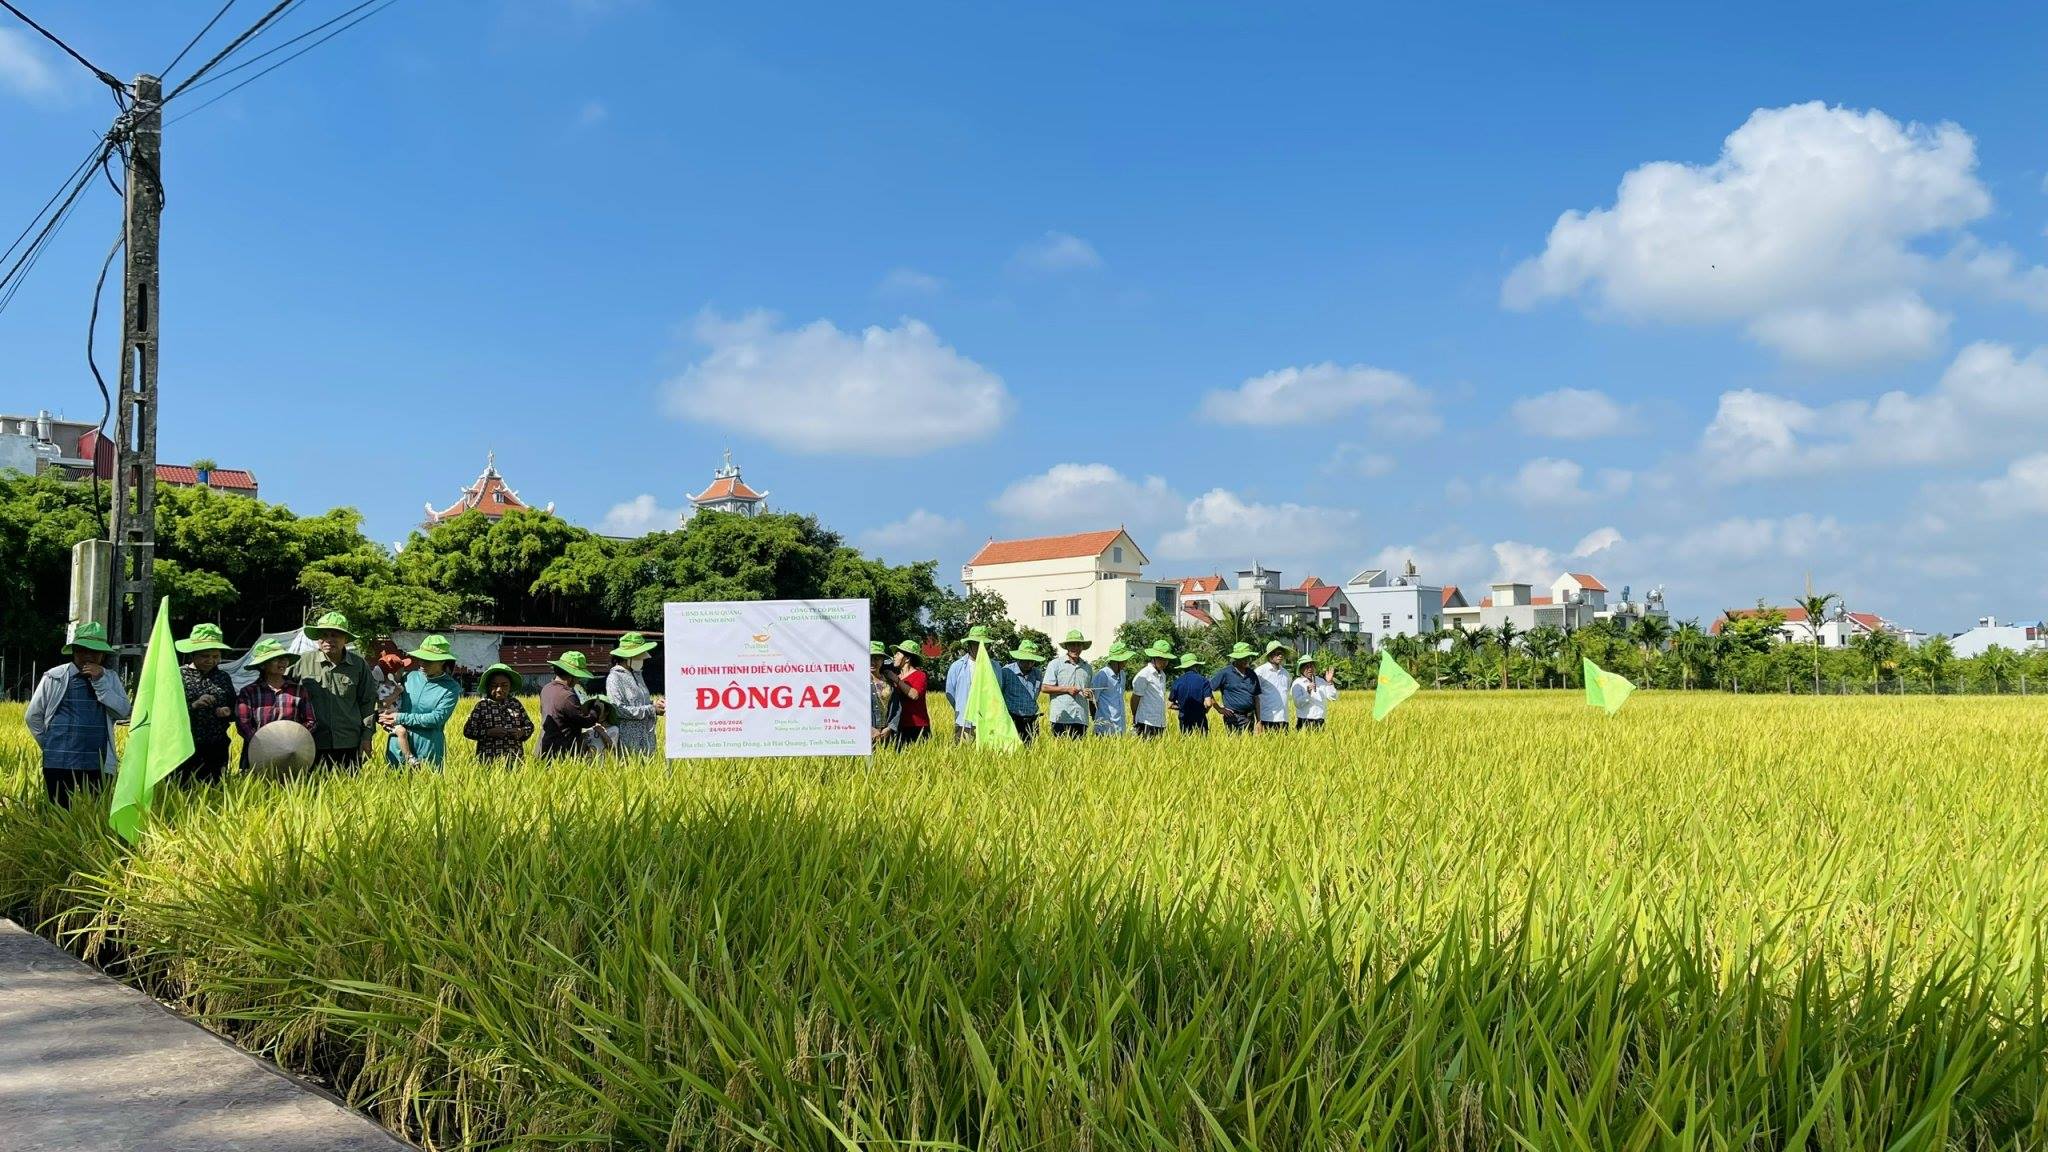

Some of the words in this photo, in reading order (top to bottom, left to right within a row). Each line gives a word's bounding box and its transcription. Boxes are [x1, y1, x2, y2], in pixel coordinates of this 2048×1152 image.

[681, 664, 696, 676] MÔ
[698, 664, 720, 675] HÌNH
[721, 663, 749, 675] TRÌNH
[695, 680, 793, 710] ĐÔNG
[798, 684, 841, 708] A2
